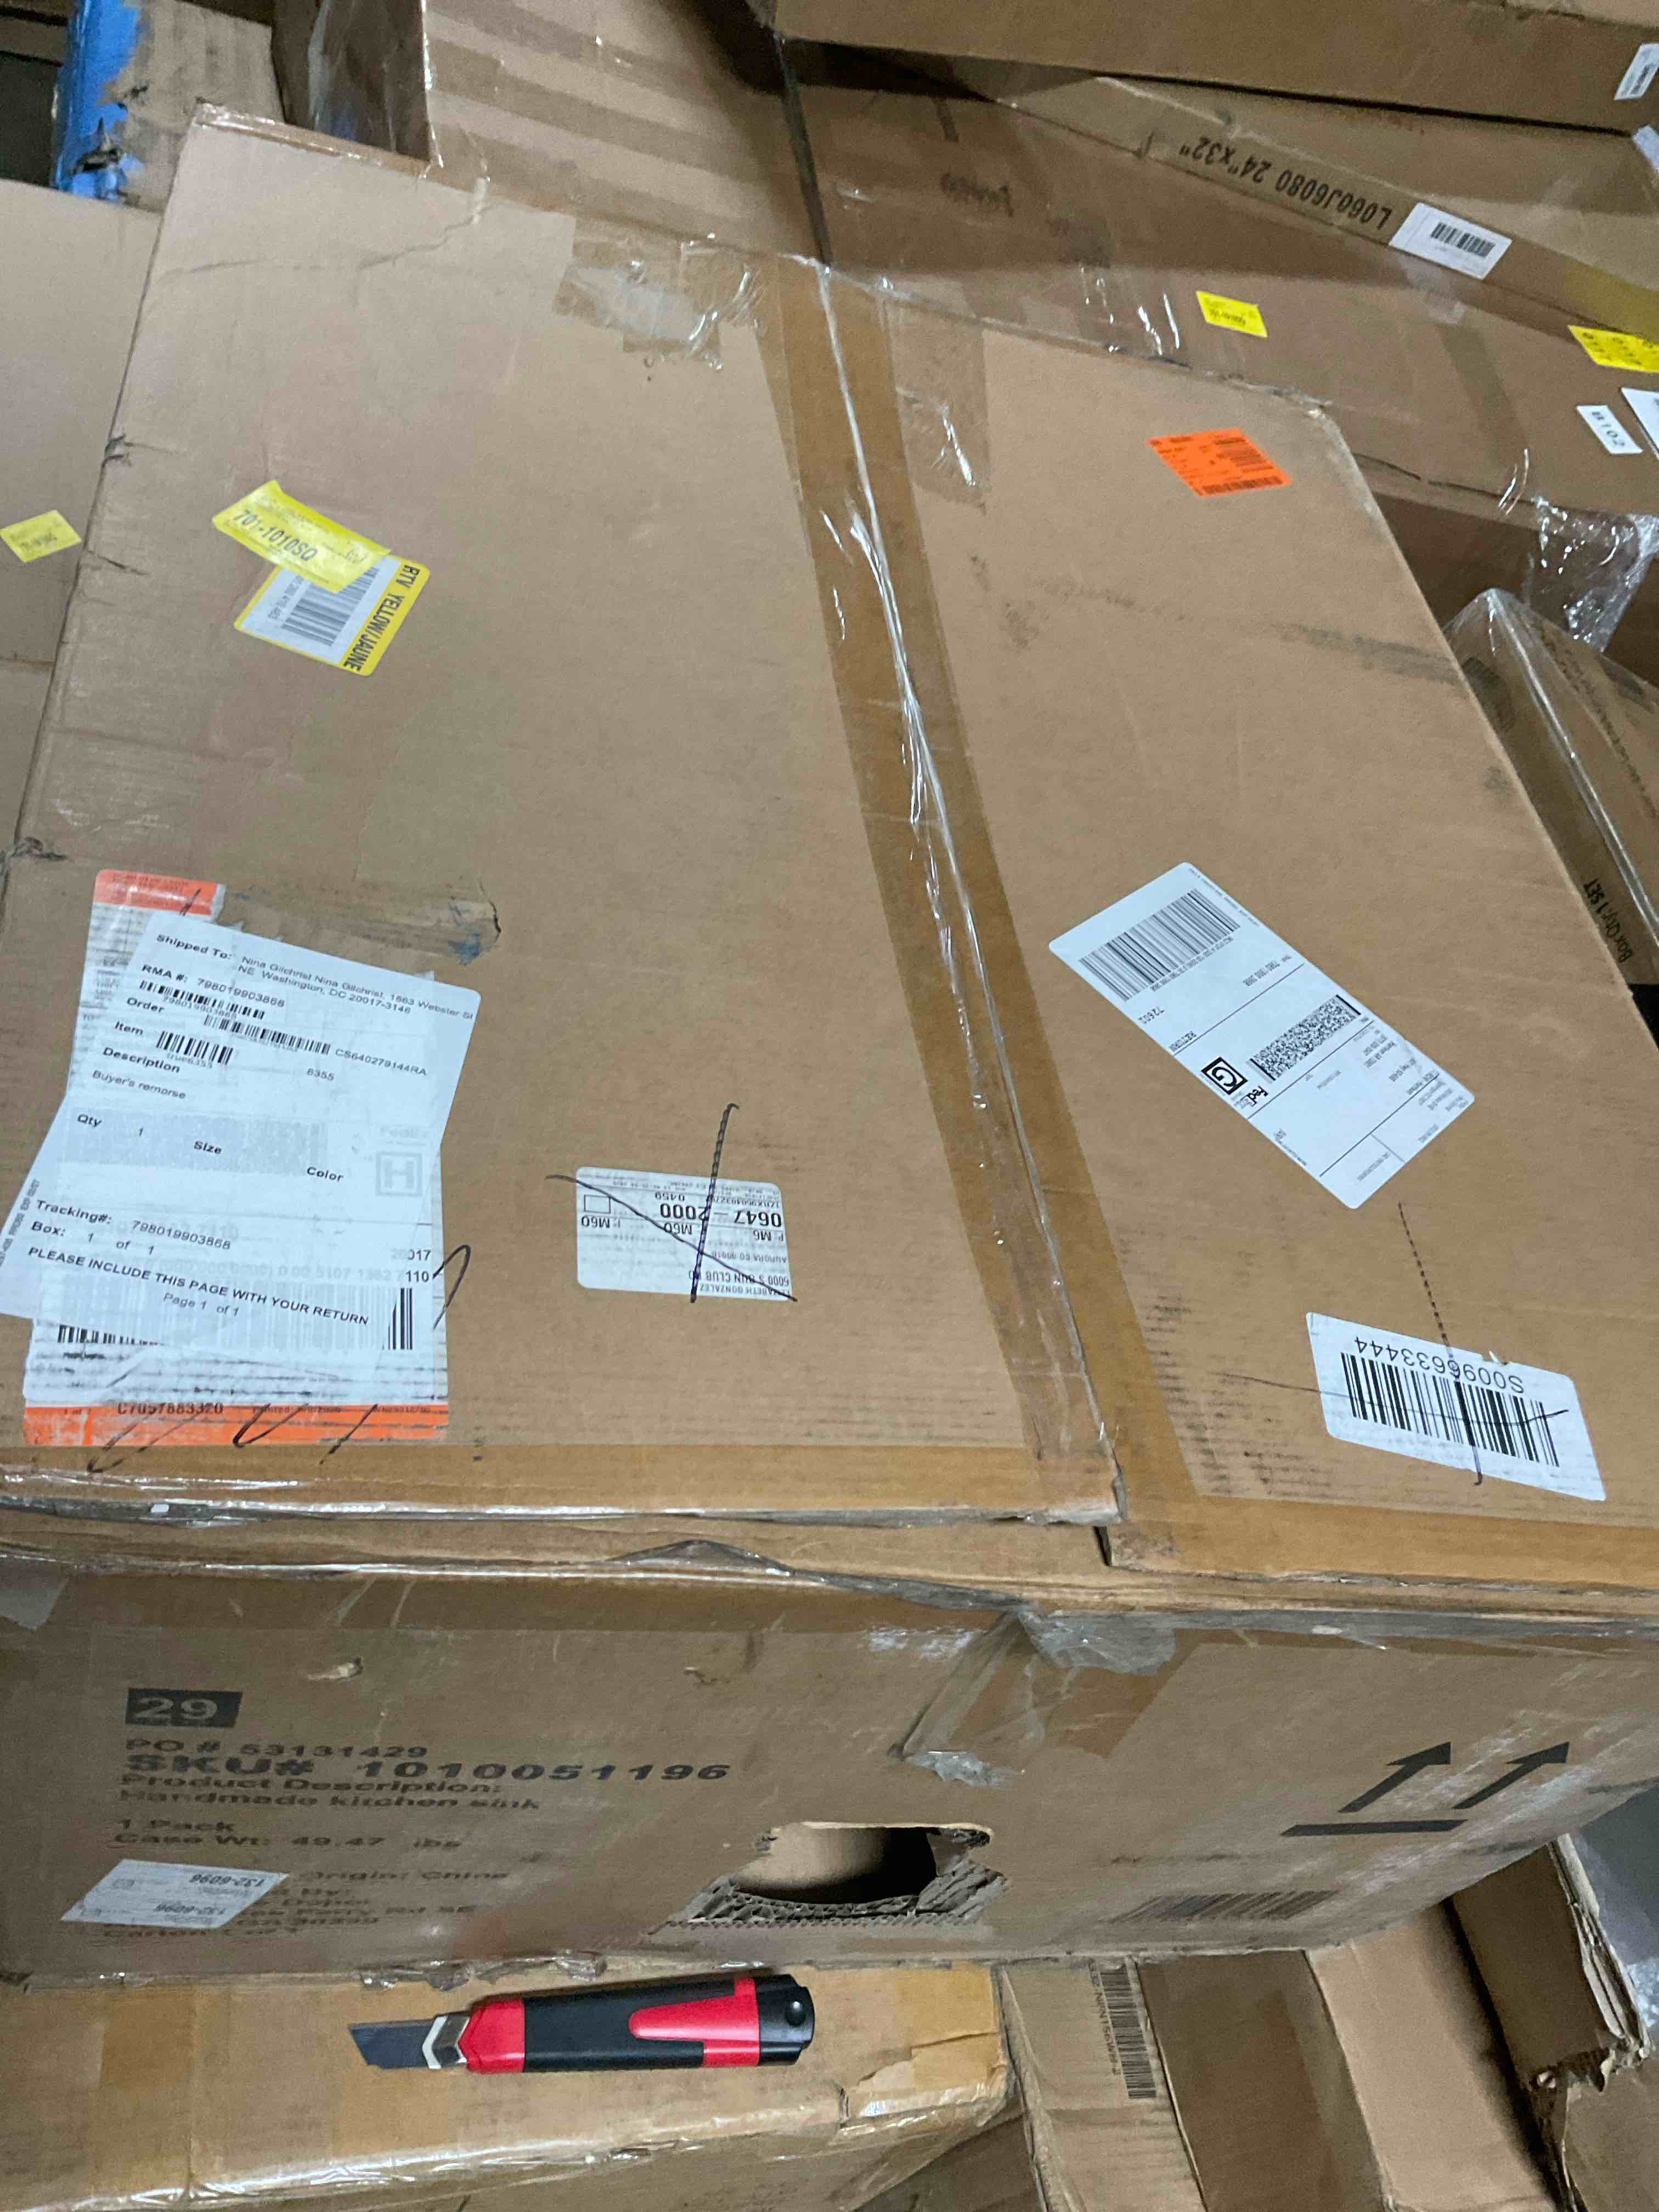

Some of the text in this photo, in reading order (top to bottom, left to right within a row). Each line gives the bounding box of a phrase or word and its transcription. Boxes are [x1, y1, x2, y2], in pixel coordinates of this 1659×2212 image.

[396, 565, 421, 589] RTV
[343, 594, 405, 672] YELLOW/JAUNE
[142, 964, 172, 979] RMA
[197, 978, 285, 1008] 798019903868
[156, 934, 208, 953] Shipped
[213, 949, 232, 960] To:
[241, 956, 266, 968] Nina
[269, 963, 312, 981] Gilchrist
[315, 976, 338, 988] Nina
[418, 1001, 459, 1017] Webster
[238, 965, 411, 1014] NE Washington, DC 20017-3146
[127, 997, 165, 1013] Order
[103, 1047, 180, 1073] Description
[114, 1021, 335, 1081] Item 6355
[92, 1069, 186, 1099] Buyer's remorse
[77, 1113, 102, 1127] Qty
[194, 1140, 222, 1155] Size
[306, 1166, 345, 1182] Color
[580, 1216, 610, 1228] M60
[659, 1203, 707, 1221] 2000
[734, 1209, 781, 1228] 0647
[36, 1199, 231, 1251] Tracking#: 798019903868
[31, 1220, 154, 1255] Box: 1 of 1
[28, 1247, 85, 1266] PLEASE
[88, 1259, 151, 1280] INCLUDE
[155, 1272, 185, 1287] THIS
[188, 1280, 229, 1296] PAGE
[233, 1288, 267, 1304] WITH
[272, 1297, 309, 1313] YOUR
[312, 1306, 369, 1326] RETURN
[706, 1271, 731, 1281] CLUB
[768, 1276, 789, 1286] 6000
[699, 1284, 743, 1293] GONZALEZ
[163, 1293, 240, 1317] Page 1 of 1
[1355, 1336, 1525, 1394] S0096633444
[133, 1697, 219, 1720] 29
[125, 1739, 185, 1753] PO
[239, 1743, 428, 1757] 53131429
[126, 1755, 731, 1780] SKU# 1010051196
[121, 1773, 271, 1790] Product
[119, 1790, 318, 1807] Handmade
[119, 1819, 235, 1832] 1 Pack
[113, 1833, 203, 1844] Case
